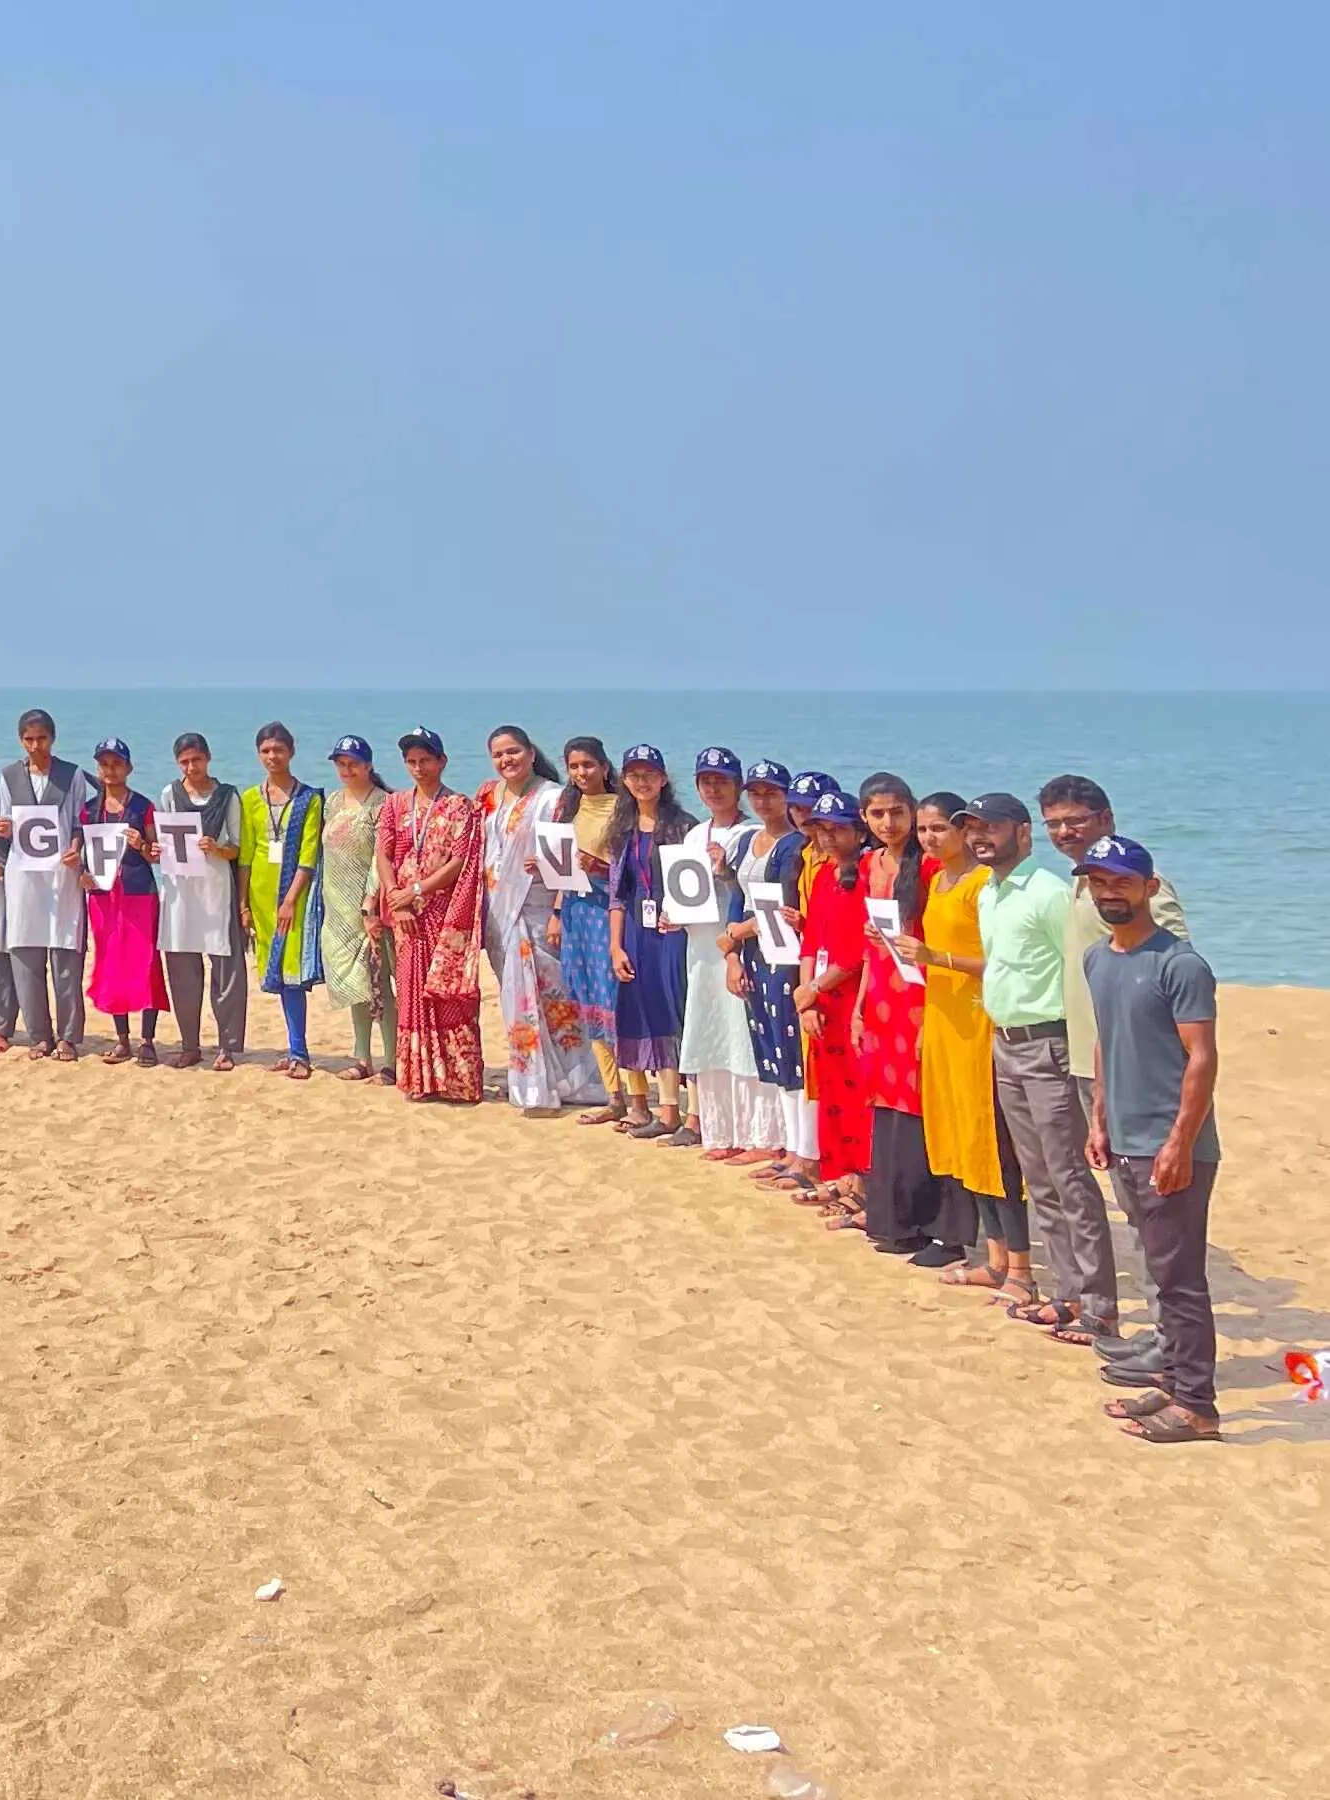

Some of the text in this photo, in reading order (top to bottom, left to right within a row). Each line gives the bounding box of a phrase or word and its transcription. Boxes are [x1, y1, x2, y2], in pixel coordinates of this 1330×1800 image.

[18, 817, 59, 858] G
[92, 836, 125, 876] H
[160, 825, 198, 864] T
[538, 835, 574, 877] V
[666, 858, 711, 908] O
[754, 899, 787, 948] T
